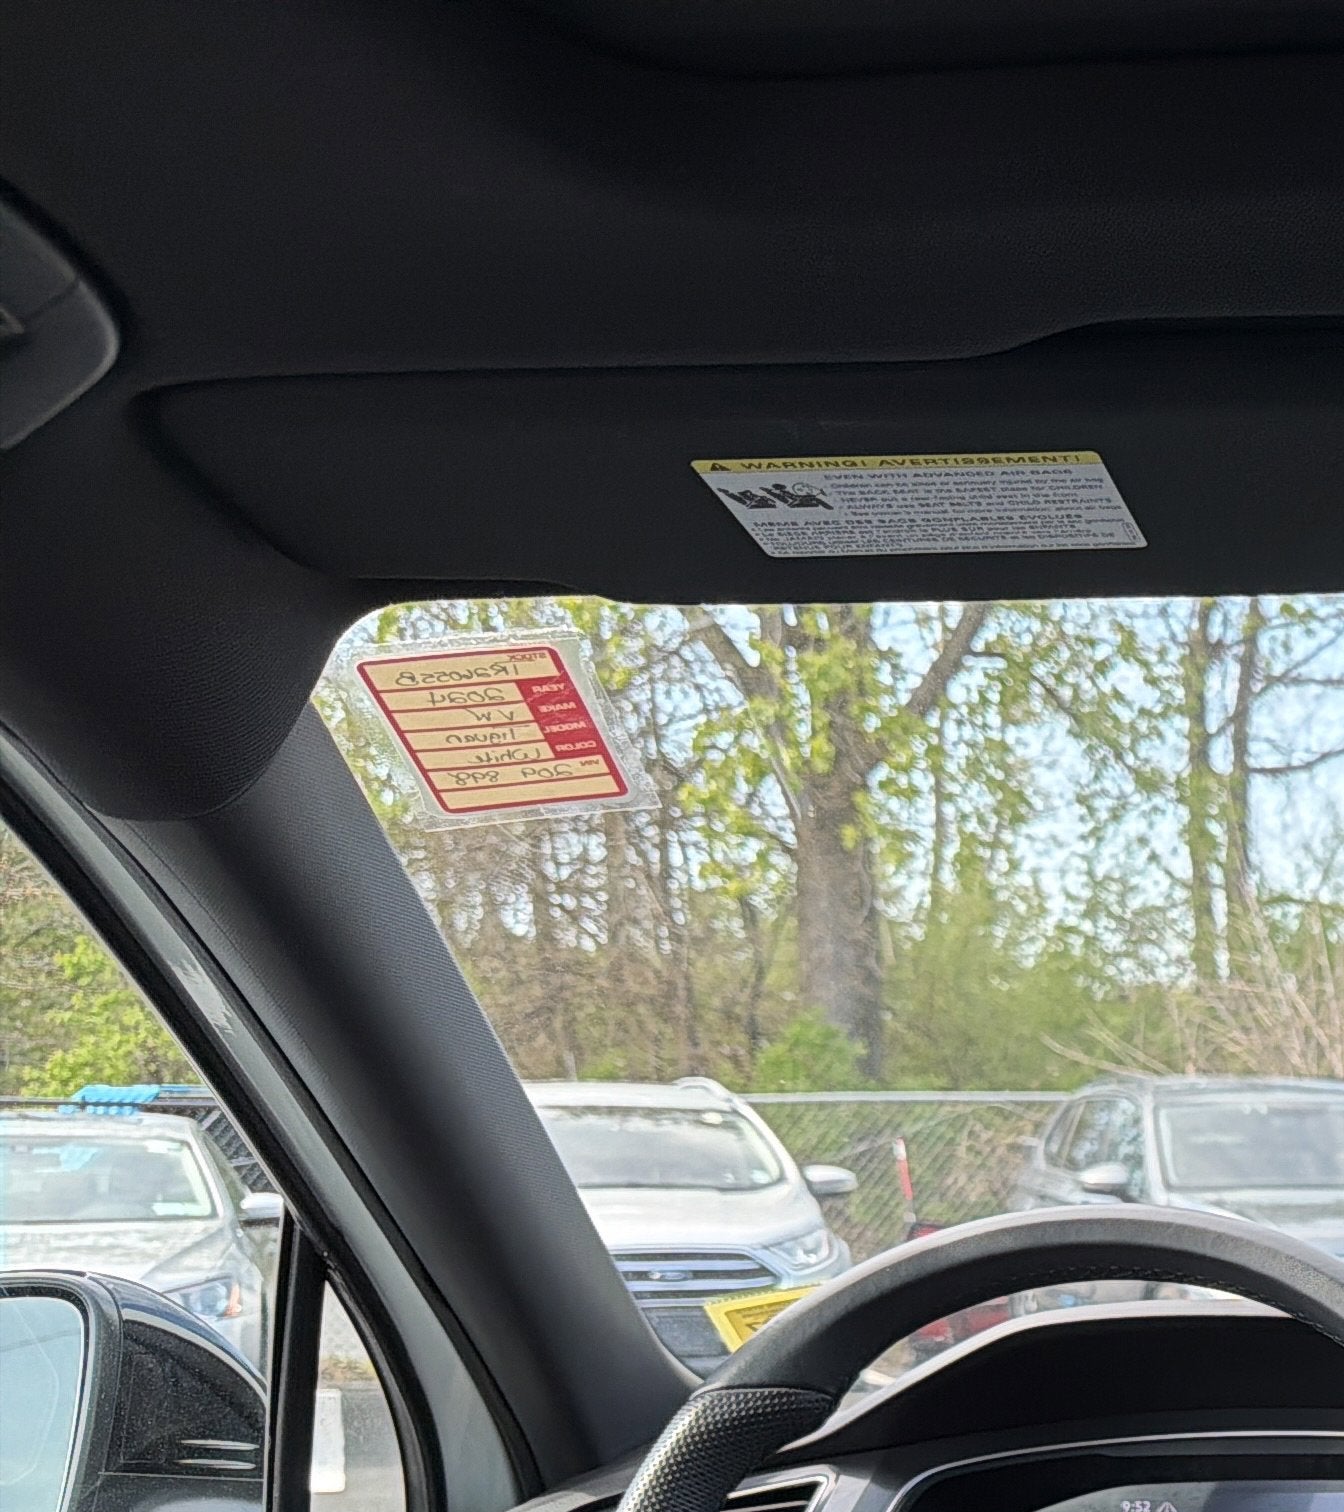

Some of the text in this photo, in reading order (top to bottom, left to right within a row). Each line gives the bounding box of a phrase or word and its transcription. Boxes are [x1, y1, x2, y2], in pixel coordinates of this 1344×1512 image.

[741, 455, 1080, 471] WARNING! AVERTISSEMENT!
[1121, 1500, 1151, 1512] 9:52
